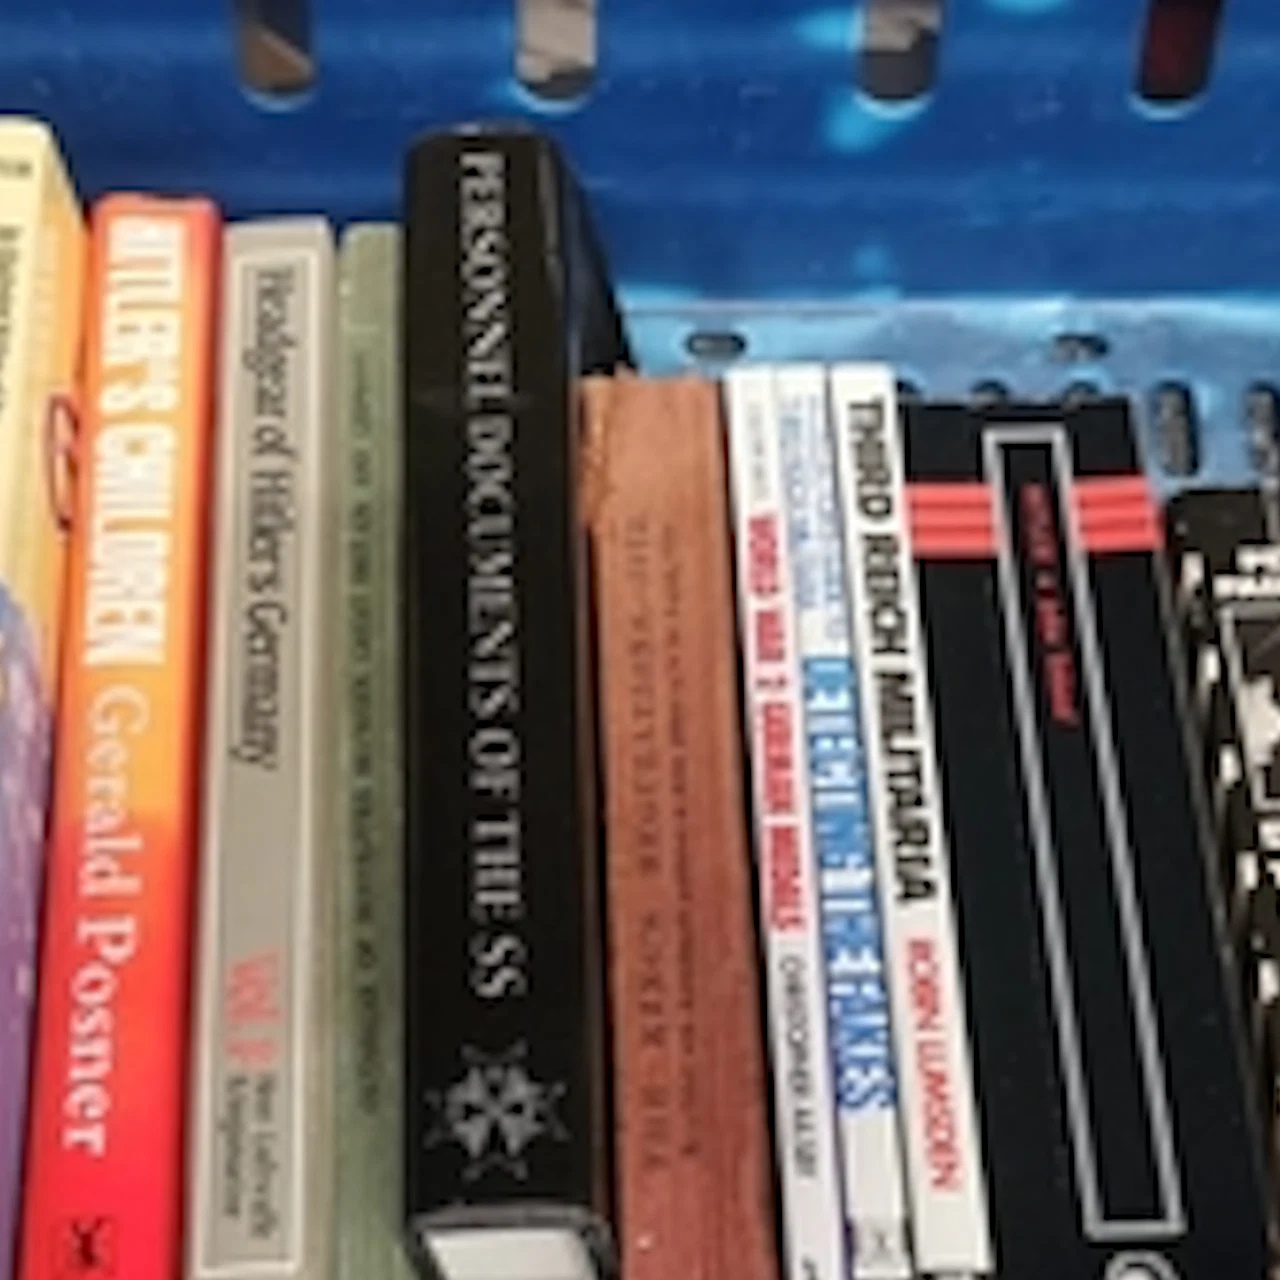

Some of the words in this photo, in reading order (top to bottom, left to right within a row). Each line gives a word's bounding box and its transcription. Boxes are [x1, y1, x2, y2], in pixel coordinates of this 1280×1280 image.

[98, 217, 188, 413] HITLER'S
[241, 265, 297, 420] Headgear
[460, 152, 512, 410] PERSONNEL
[250, 424, 296, 462] of
[846, 399, 894, 523] THIRD
[83, 422, 179, 669] CHILDREN
[247, 470, 296, 594] Hitler's
[465, 414, 522, 718] DOCUMENTS
[746, 514, 782, 597] WORLD
[755, 610, 787, 662] WAR
[860, 533, 909, 657] REICH
[229, 604, 287, 771] Germany
[78, 682, 151, 898] Gerald
[470, 726, 520, 800] OF
[760, 700, 797, 815] GERMAN
[802, 655, 874, 872] DETECTING
[870, 669, 938, 906] MILITARIA
[472, 807, 522, 922] THE
[767, 824, 809, 935] MEDALS
[470, 928, 528, 1000] SS
[824, 890, 883, 976] THE
[904, 937, 949, 1033] ROBIN
[61, 913, 137, 1156] Posner
[830, 978, 896, 1114] FAKES
[916, 1040, 965, 1195] LUMSDEN
